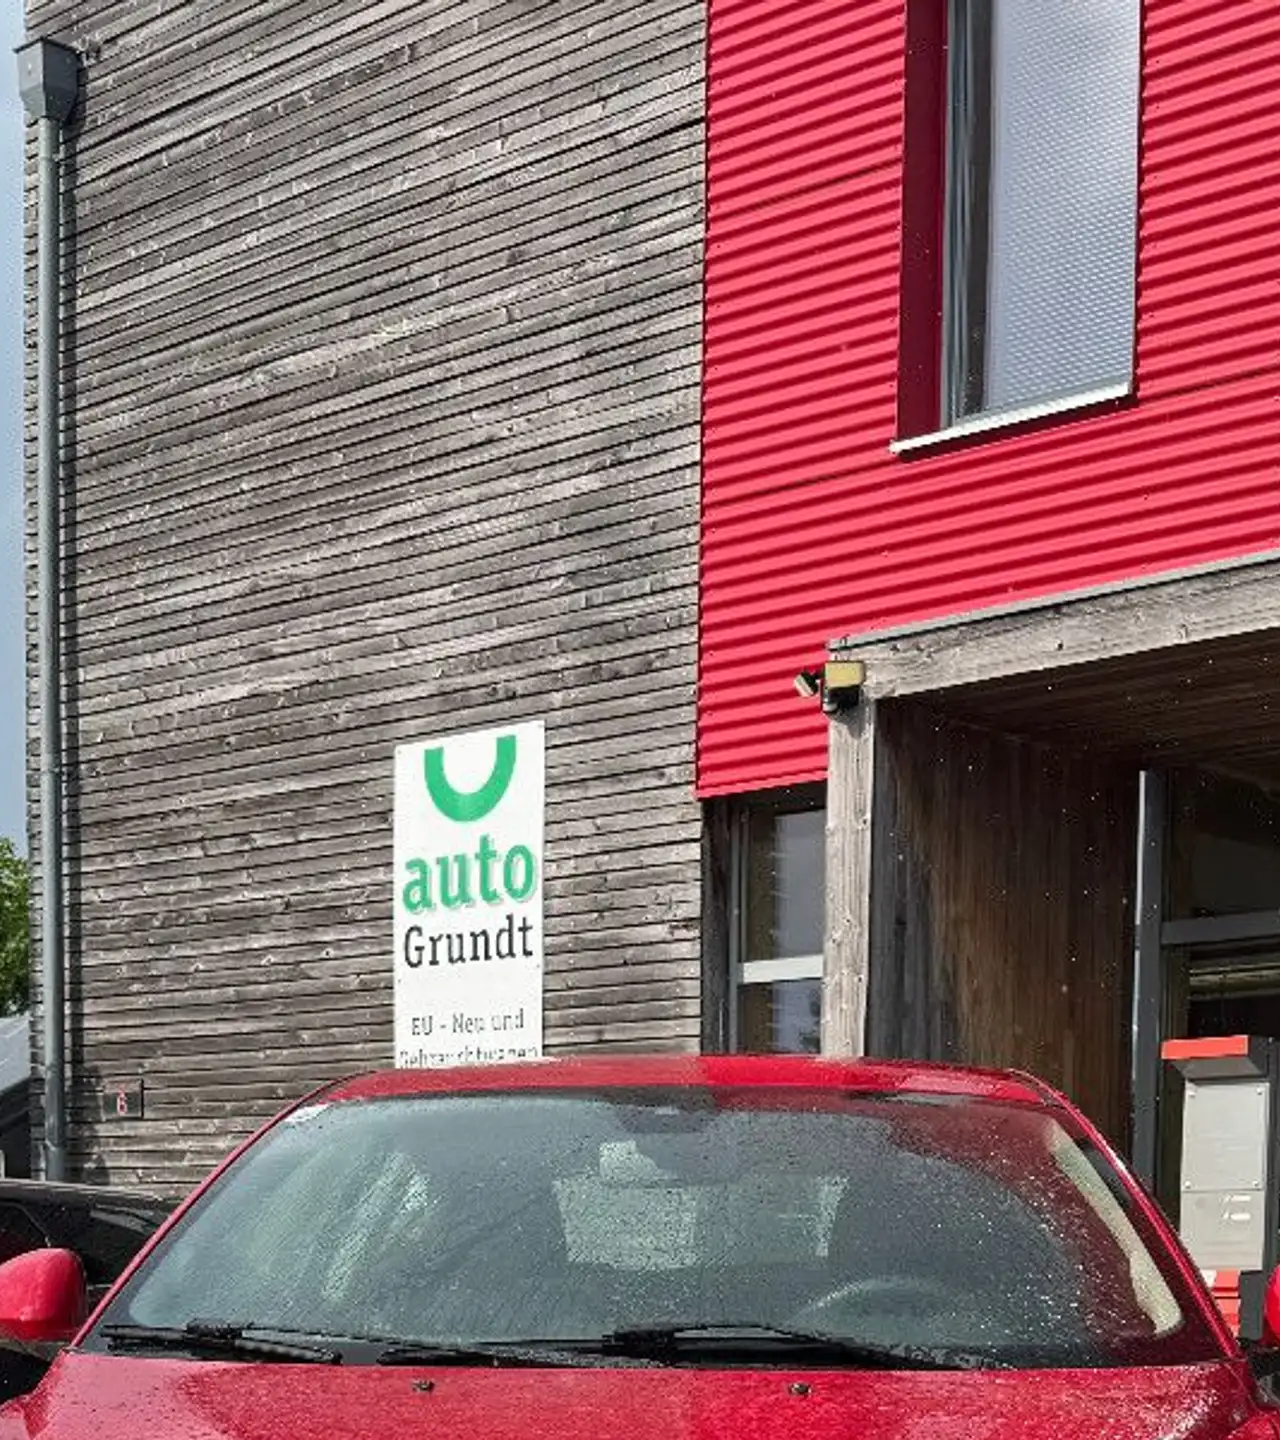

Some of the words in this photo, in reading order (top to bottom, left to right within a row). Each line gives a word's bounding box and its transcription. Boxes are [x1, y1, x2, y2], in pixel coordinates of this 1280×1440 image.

[402, 834, 535, 912] auto
[403, 914, 534, 968] Grundt
[412, 1015, 433, 1036] EU
[491, 1007, 524, 1031] und
